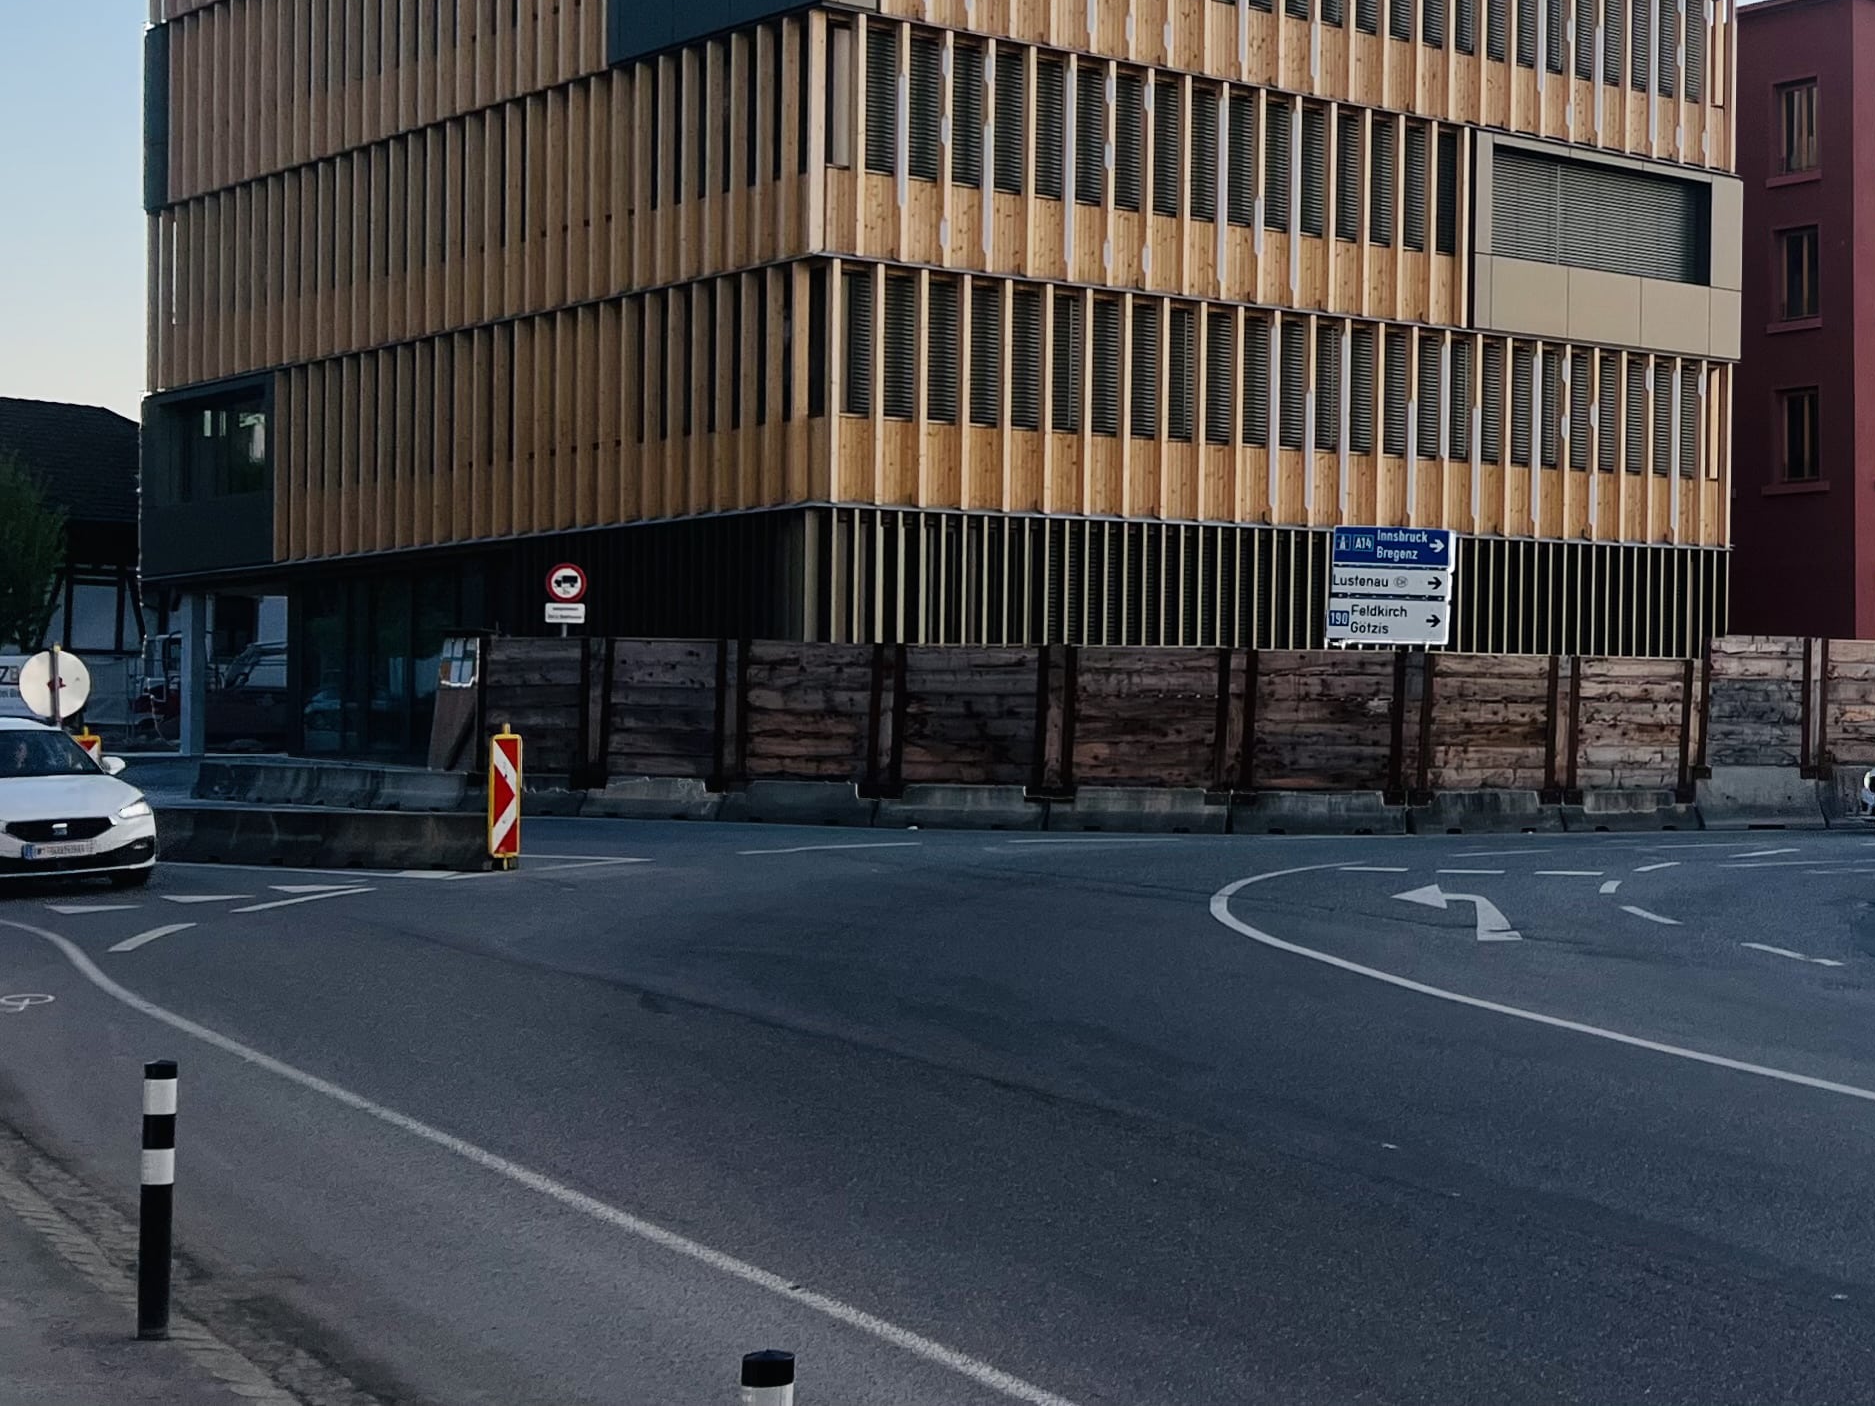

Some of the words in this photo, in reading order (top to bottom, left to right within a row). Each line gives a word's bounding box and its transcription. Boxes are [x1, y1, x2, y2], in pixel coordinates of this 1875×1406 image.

[1355, 537, 1372, 549] A14
[1377, 530, 1427, 543] Innsbruck
[1376, 546, 1418, 562] Bregenz
[1333, 575, 1389, 587] Lustenau
[1351, 604, 1408, 617] Feldkirch
[1331, 612, 1348, 624] 190
[1350, 621, 1389, 634] Götzis
